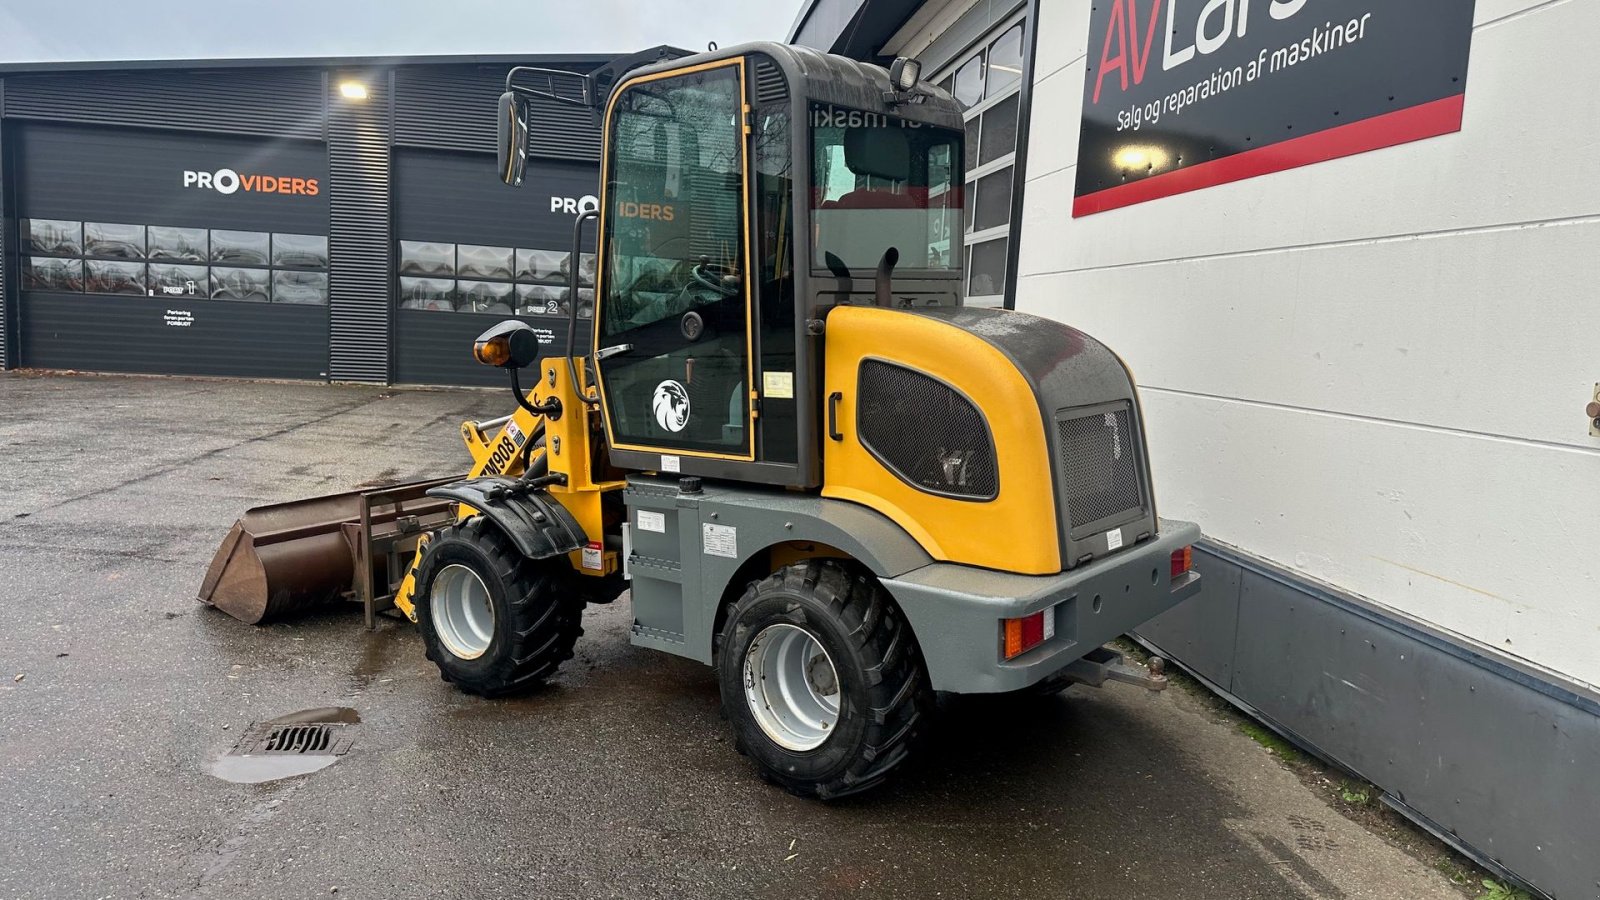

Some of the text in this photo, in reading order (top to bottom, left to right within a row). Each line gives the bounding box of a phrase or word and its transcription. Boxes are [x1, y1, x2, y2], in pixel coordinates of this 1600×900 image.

[1116, 12, 1371, 132] Salg og reparation af maskiner
[183, 168, 319, 196] PROVIDERS
[186, 280, 195, 295] 1
[547, 300, 558, 314] 2
